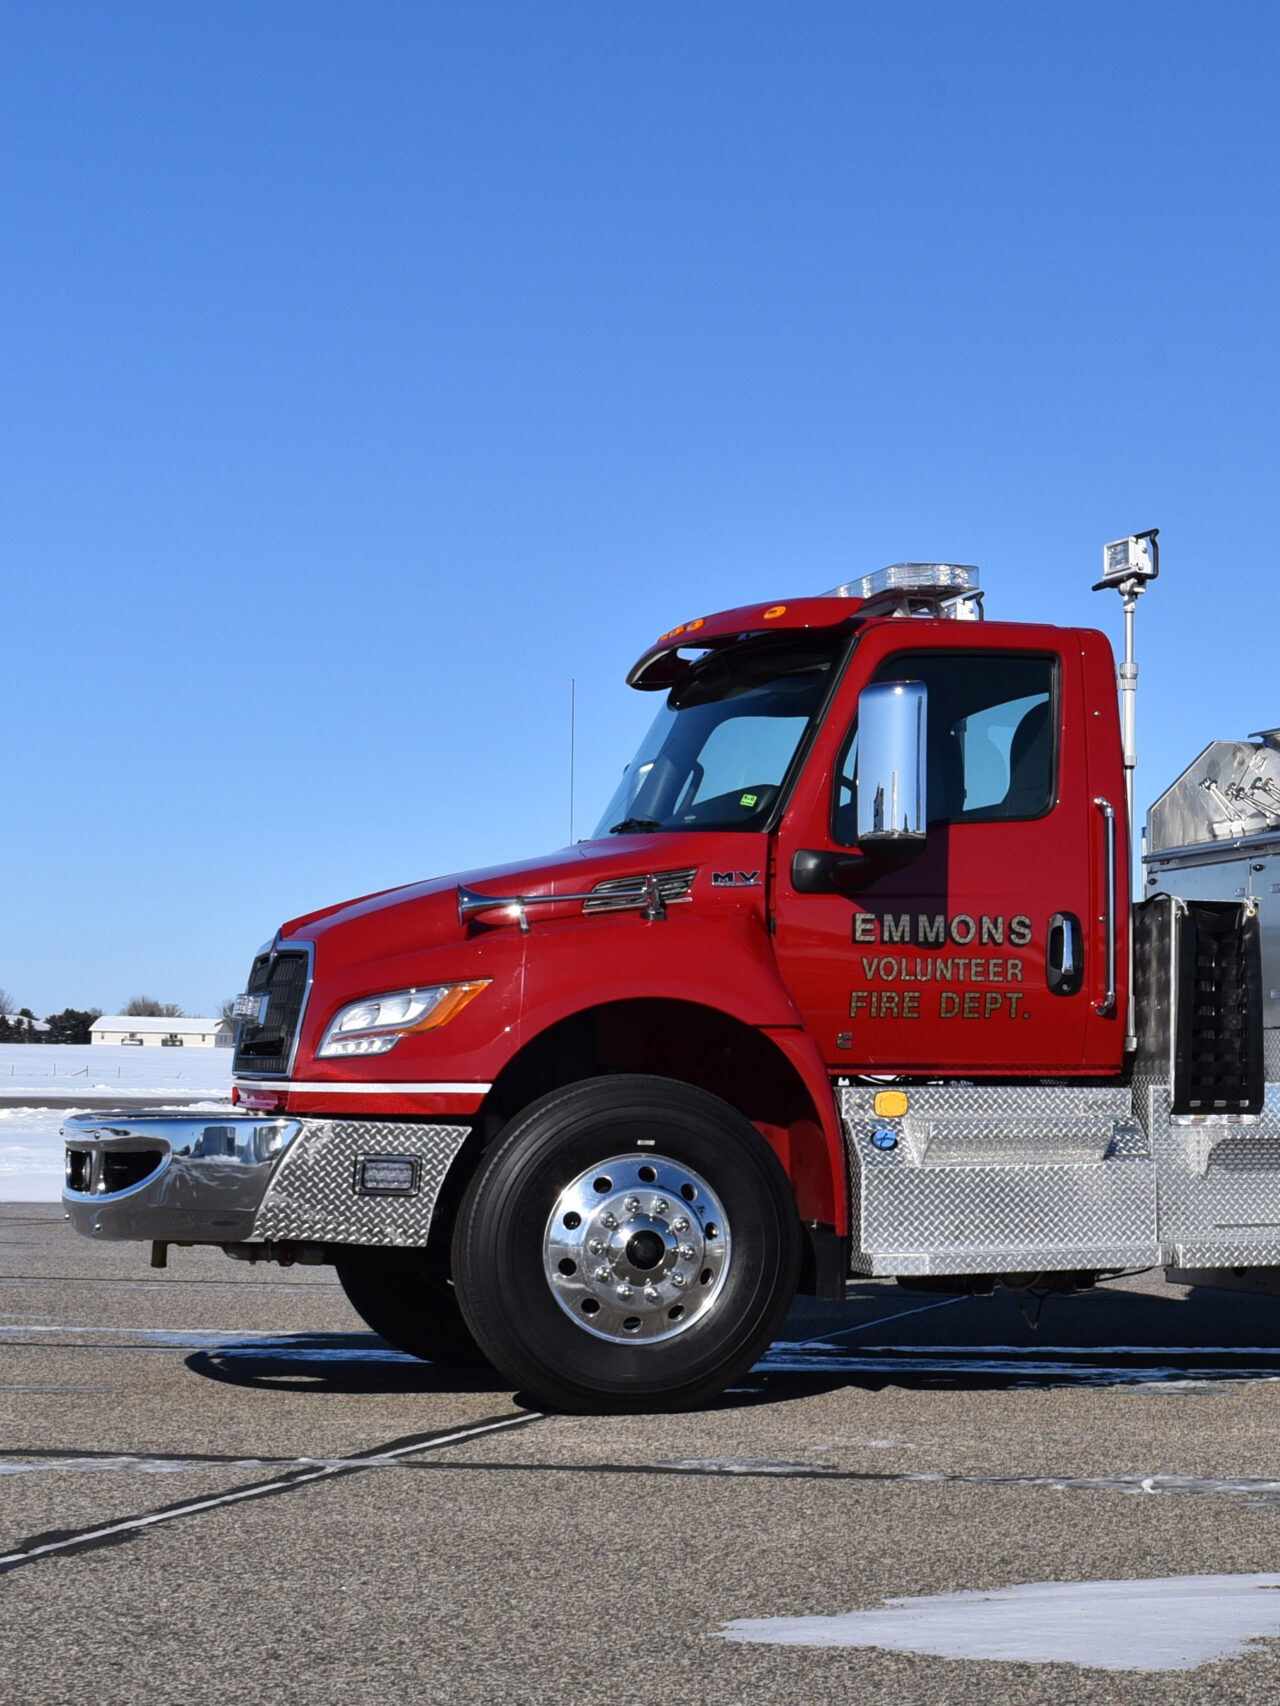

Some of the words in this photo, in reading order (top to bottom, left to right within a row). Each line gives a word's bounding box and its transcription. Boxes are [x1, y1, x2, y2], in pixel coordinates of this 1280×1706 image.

[712, 870, 761, 885] MV
[853, 912, 1033, 946] EMMONS
[861, 956, 1023, 982] VOLUNTEER
[849, 991, 921, 1018] FIRE
[939, 991, 1031, 1019] DEPT.
